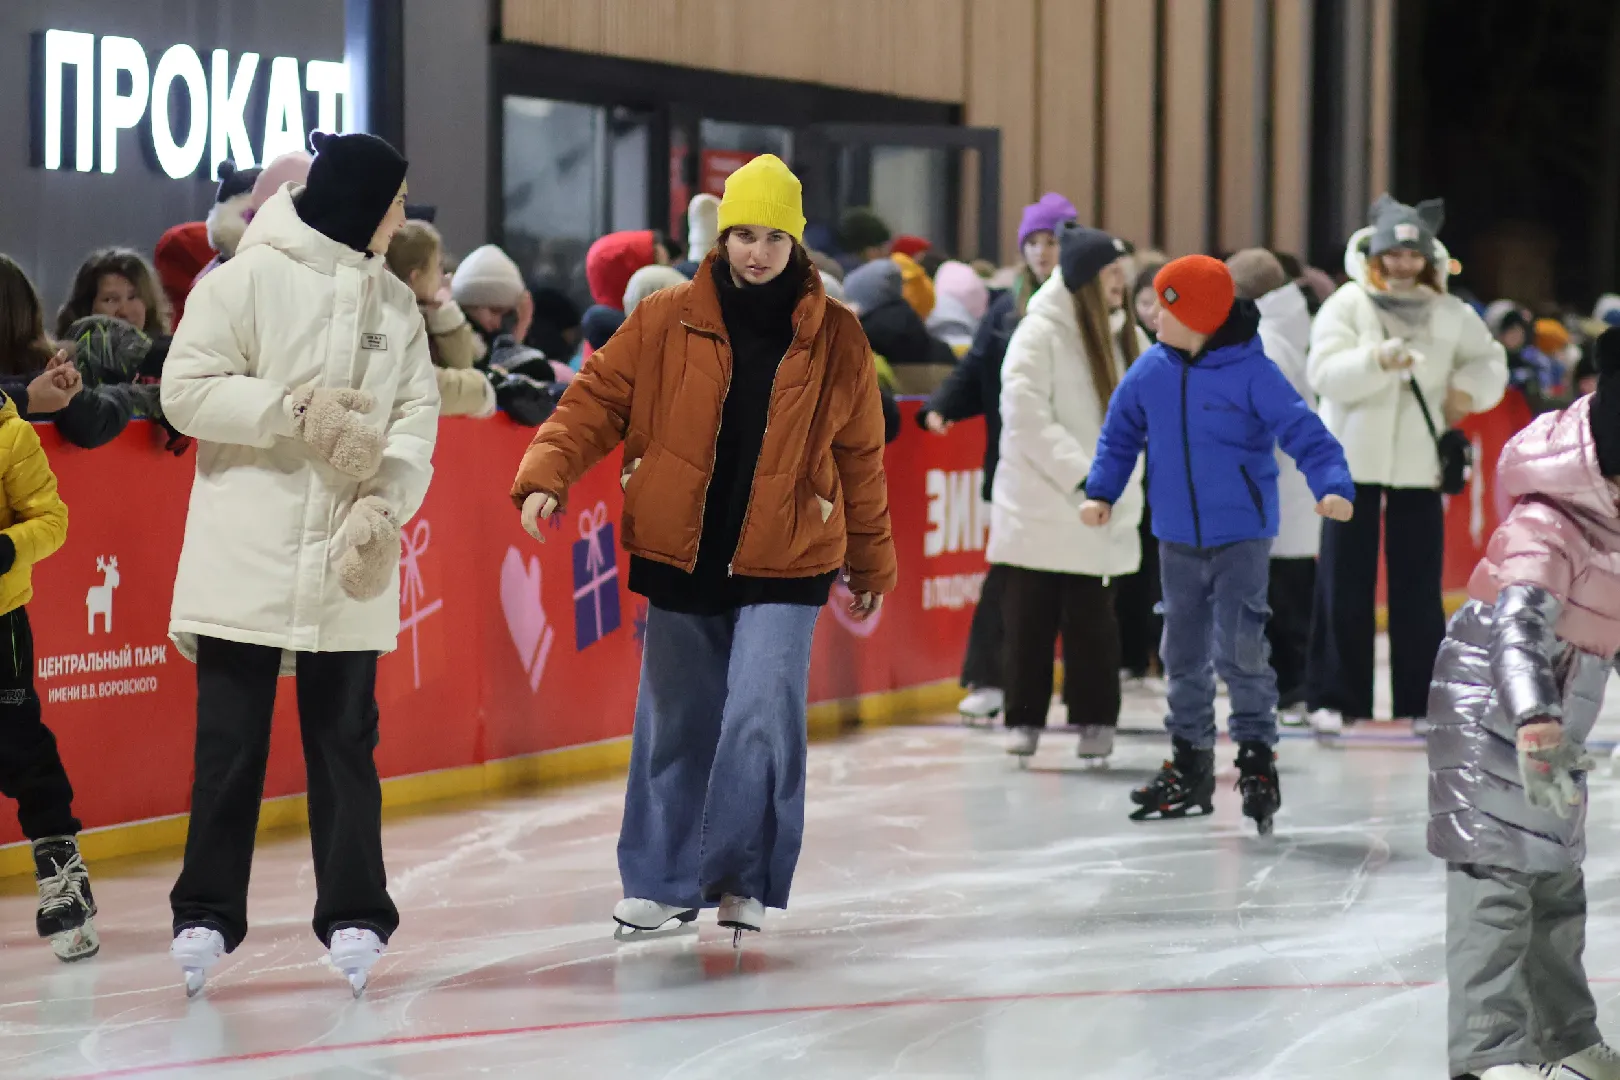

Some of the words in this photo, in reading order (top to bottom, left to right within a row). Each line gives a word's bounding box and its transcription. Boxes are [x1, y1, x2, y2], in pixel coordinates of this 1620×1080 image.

[45, 29, 350, 181] ПРОКАТ
[38, 643, 132, 680] ЦЕНТРАЛЬНЫЙ
[135, 645, 167, 666] ПАРК
[48, 685, 80, 703] ИМЕНИ
[81, 683, 98, 699] В.В.
[99, 676, 157, 698] ВОРОВСКОГО
